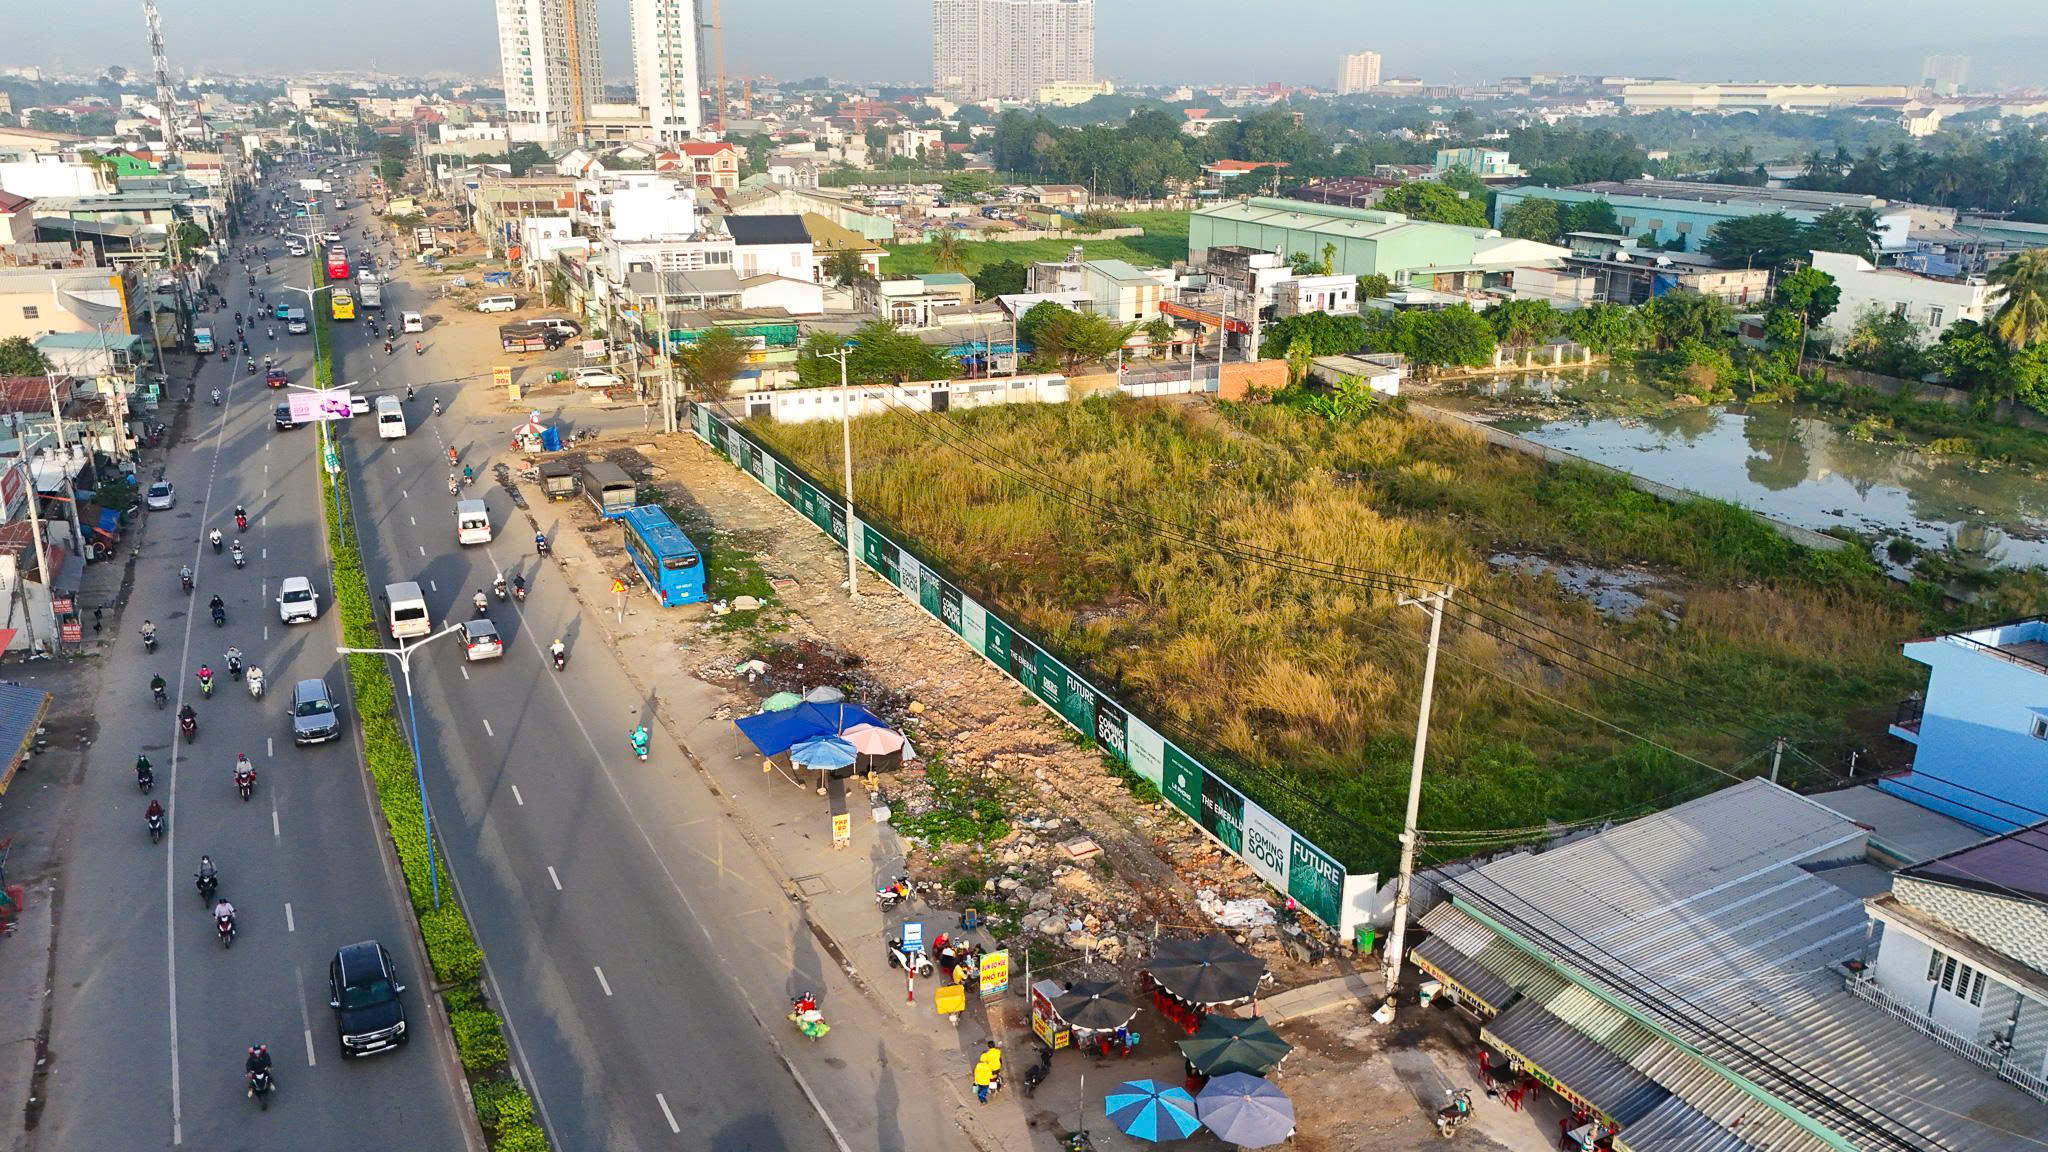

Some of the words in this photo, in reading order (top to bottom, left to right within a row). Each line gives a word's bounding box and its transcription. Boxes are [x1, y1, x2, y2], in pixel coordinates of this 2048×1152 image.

[920, 567, 940, 590] FUTURE
[942, 604, 961, 628] SOON
[1066, 674, 1094, 706] FUTURE
[1098, 714, 1124, 740] COMING
[1098, 723, 1125, 753] SOON
[1201, 793, 1213, 810] THE
[1214, 803, 1243, 832] EMERALD
[1248, 827, 1284, 860] COMING
[1248, 838, 1284, 877] SOON
[1293, 840, 1340, 886] FUTURE
